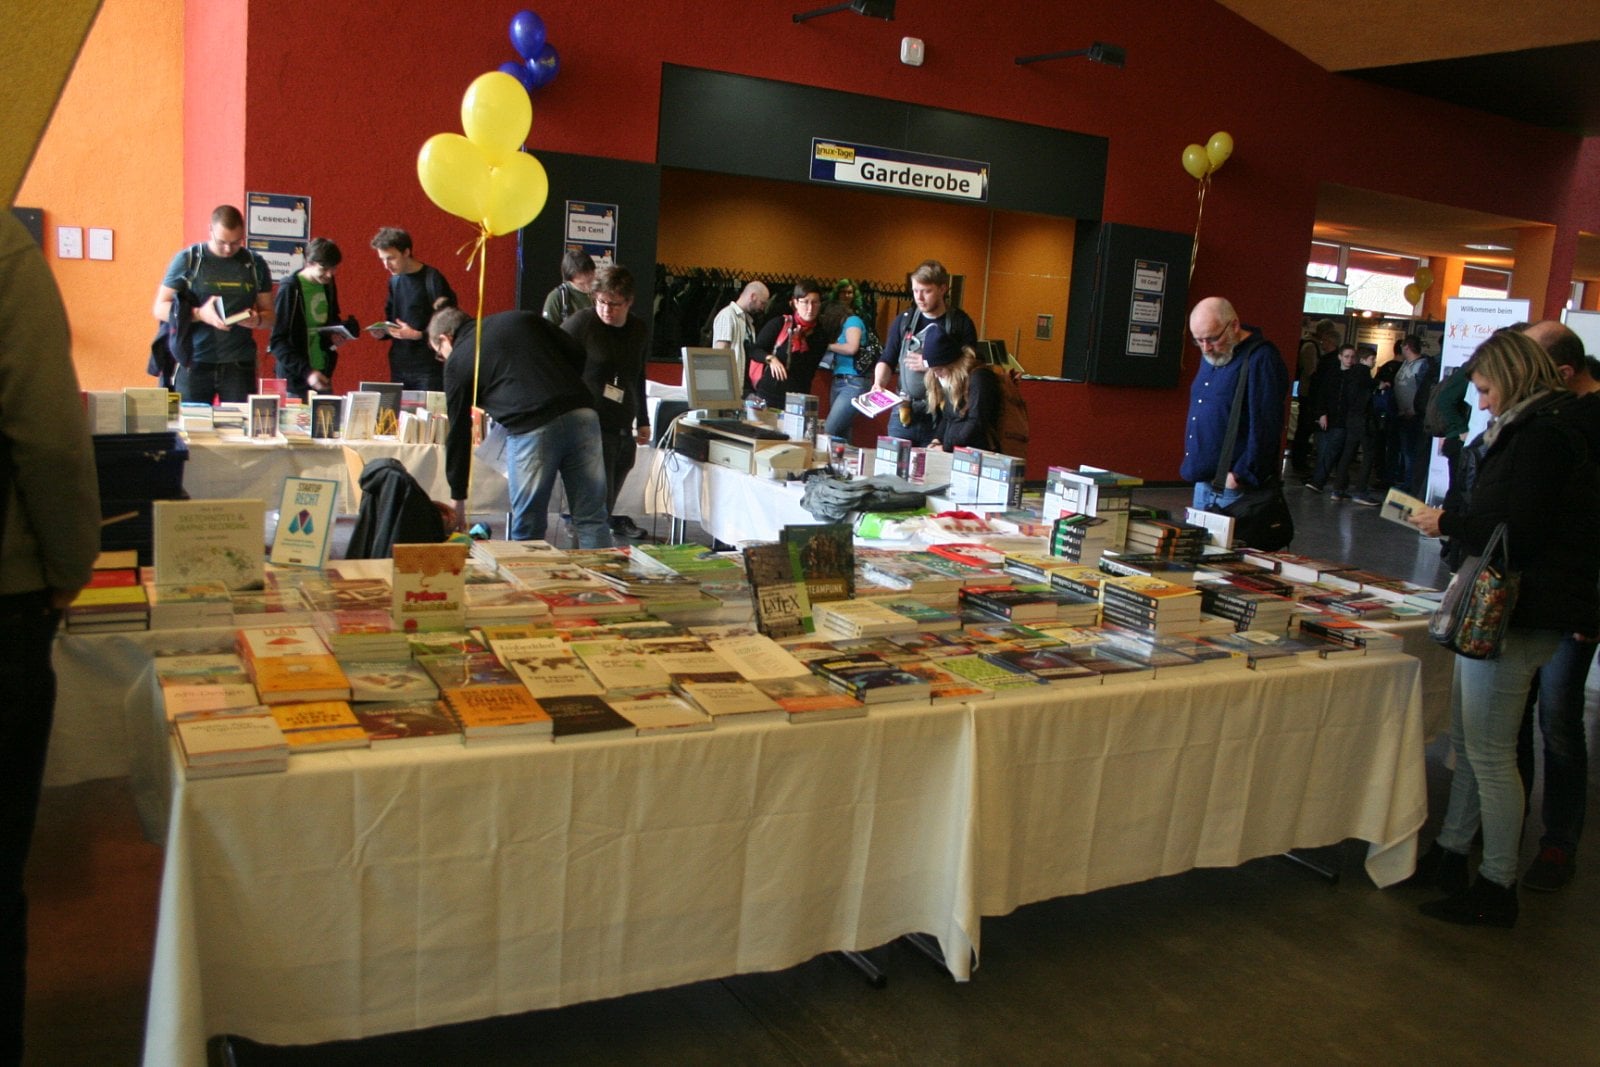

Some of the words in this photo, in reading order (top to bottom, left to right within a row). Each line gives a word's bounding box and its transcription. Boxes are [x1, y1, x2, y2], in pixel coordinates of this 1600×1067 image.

[860, 162, 970, 193] Garderobe
[258, 215, 297, 225] Leseecke
[588, 226, 605, 234] Cent
[1460, 305, 1496, 314] Willkommen
[1497, 307, 1512, 315] beim
[404, 590, 448, 604] Python
